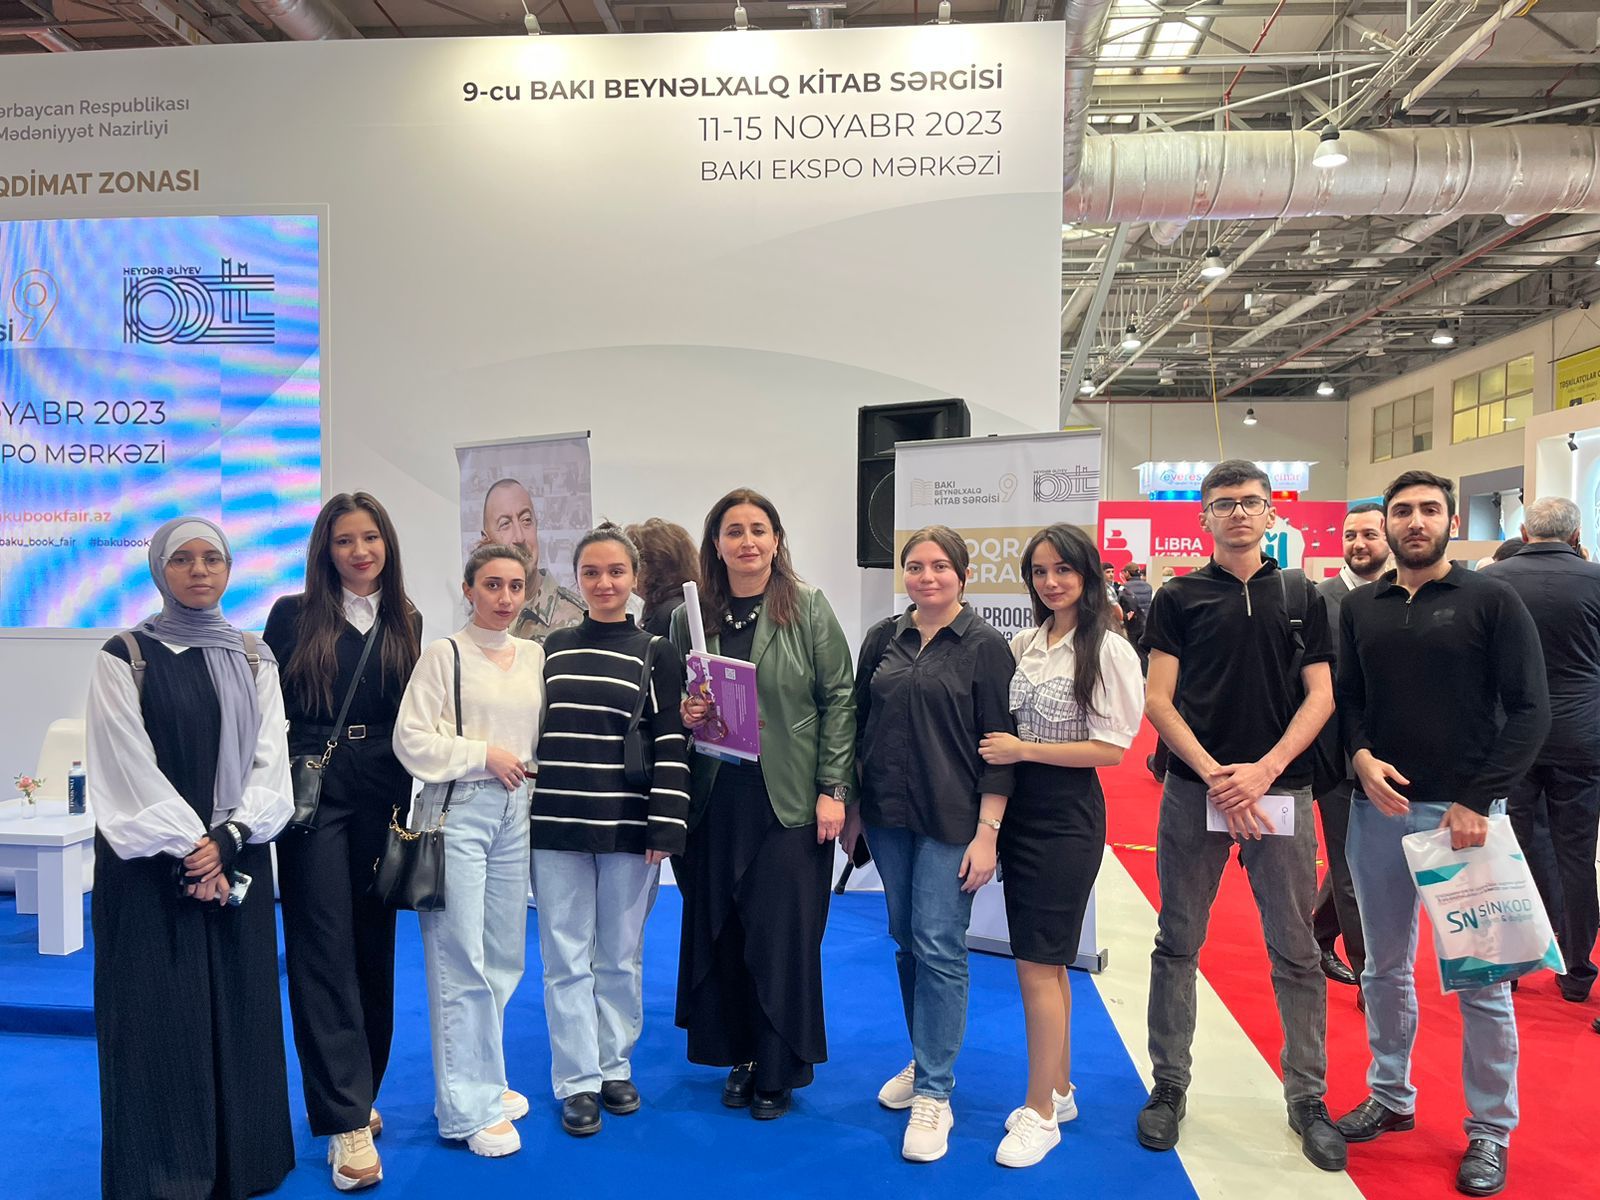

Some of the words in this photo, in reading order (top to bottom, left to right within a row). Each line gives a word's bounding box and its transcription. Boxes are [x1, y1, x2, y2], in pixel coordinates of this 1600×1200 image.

[463, 82, 520, 101] 9-cu
[530, 80, 594, 100] BAKI
[604, 75, 790, 99] BEYNƏLXALQ
[800, 68, 881, 94] KİTAB
[890, 62, 1003, 92] SƏRGİSİ
[79, 96, 190, 117] Respublikası
[98, 119, 169, 140] Nazirliyi
[698, 116, 763, 142] 11-15
[774, 112, 915, 140] NOYABR
[925, 110, 1003, 136] 2023
[701, 160, 761, 181] BAKI
[772, 157, 863, 180] EKSPO
[872, 150, 1001, 178] MƏRKƏZİ
[98, 169, 200, 194] ZONASI
[123, 267, 165, 276] HEYDƏR
[166, 264, 202, 275] ƏLİYEV
[0, 401, 84, 425] YABR
[94, 401, 166, 425] 2023
[45, 440, 165, 464] MƏRKƏZİ
[934, 481, 956, 489] BAKI
[1163, 472, 1205, 482] everes
[934, 495, 960, 506] KİTAB
[0, 509, 112, 522] kubookfair.az
